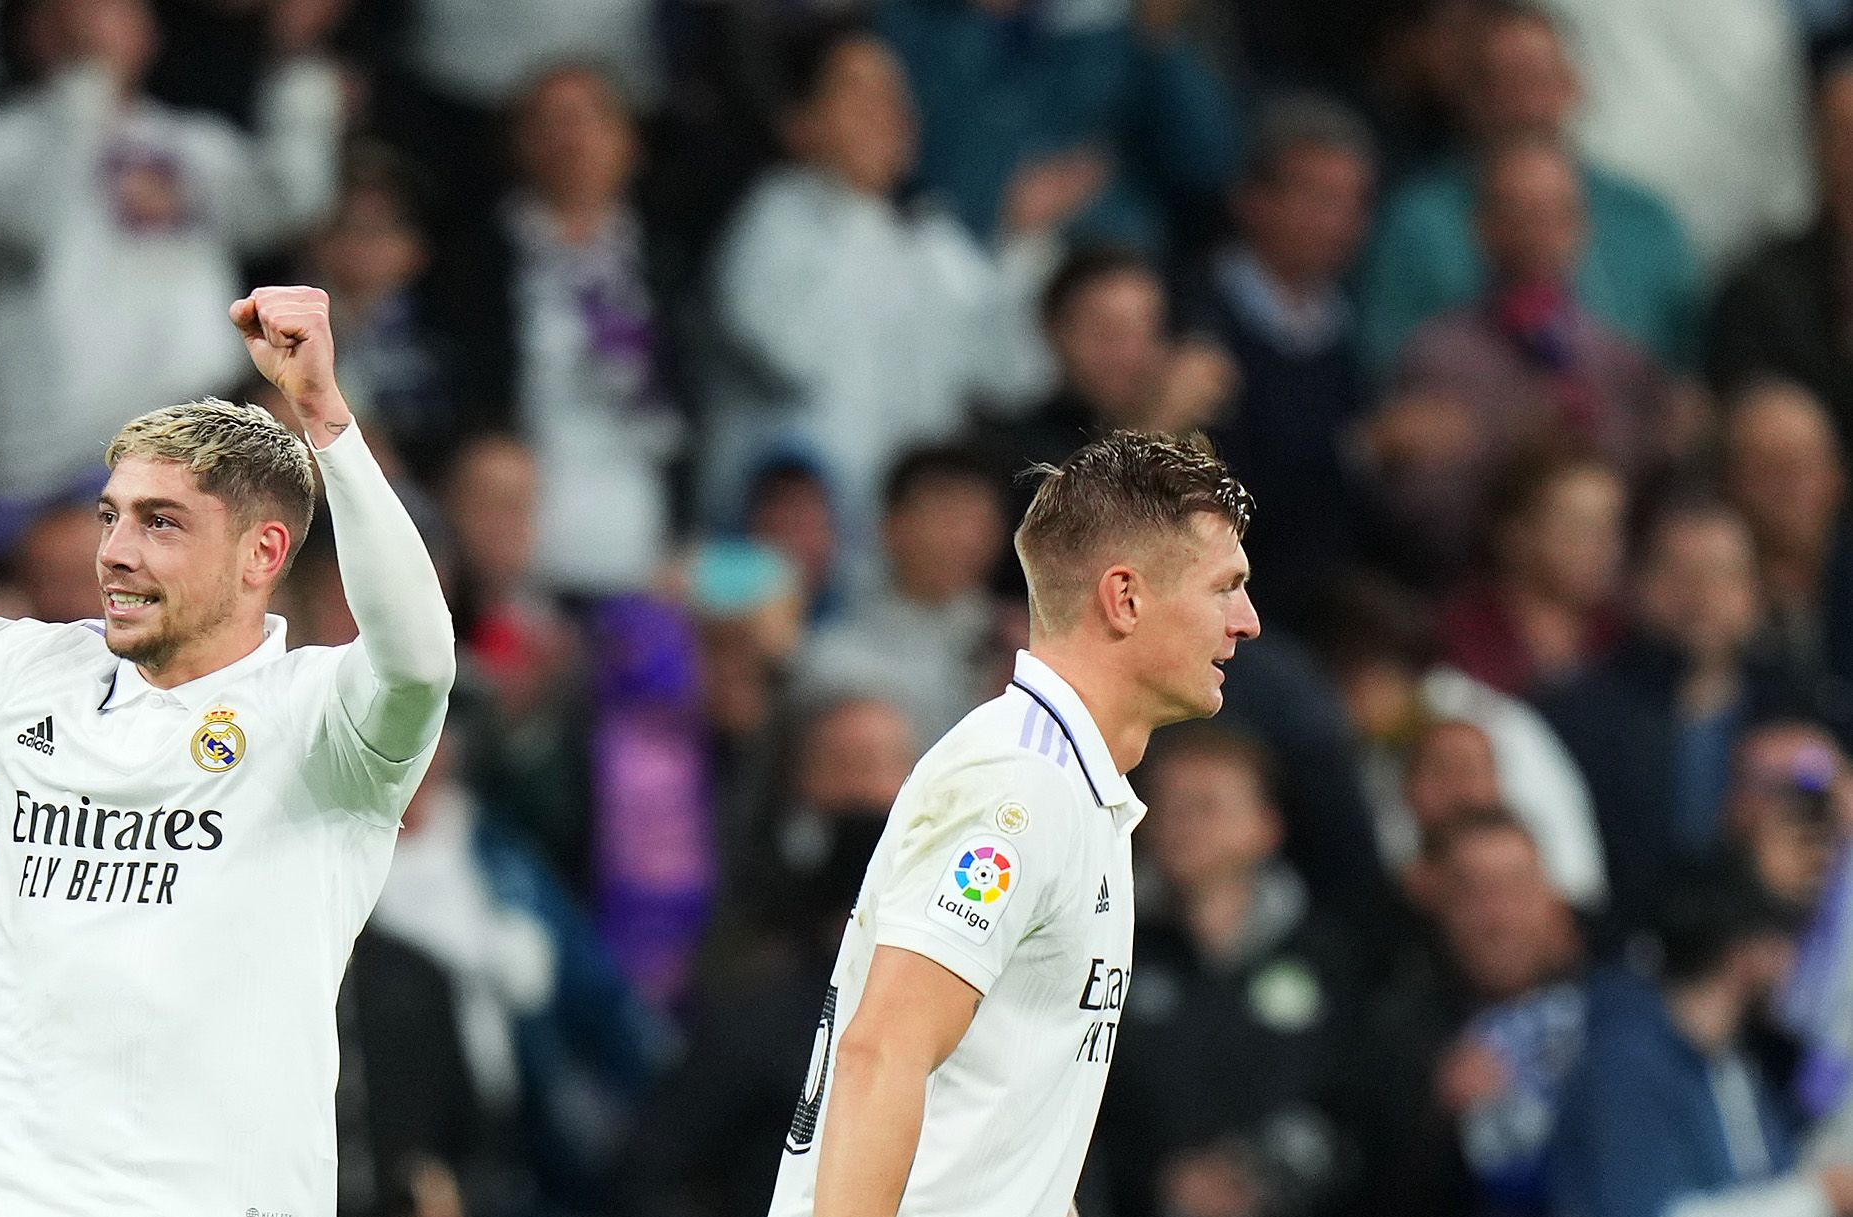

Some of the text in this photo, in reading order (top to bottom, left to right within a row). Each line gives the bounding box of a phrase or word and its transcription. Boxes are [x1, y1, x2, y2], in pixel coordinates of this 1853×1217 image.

[17, 733, 55, 756] adidas
[13, 789, 223, 851] Emirates
[19, 855, 179, 905] FLY BETTER
[938, 895, 989, 930] LaLiga
